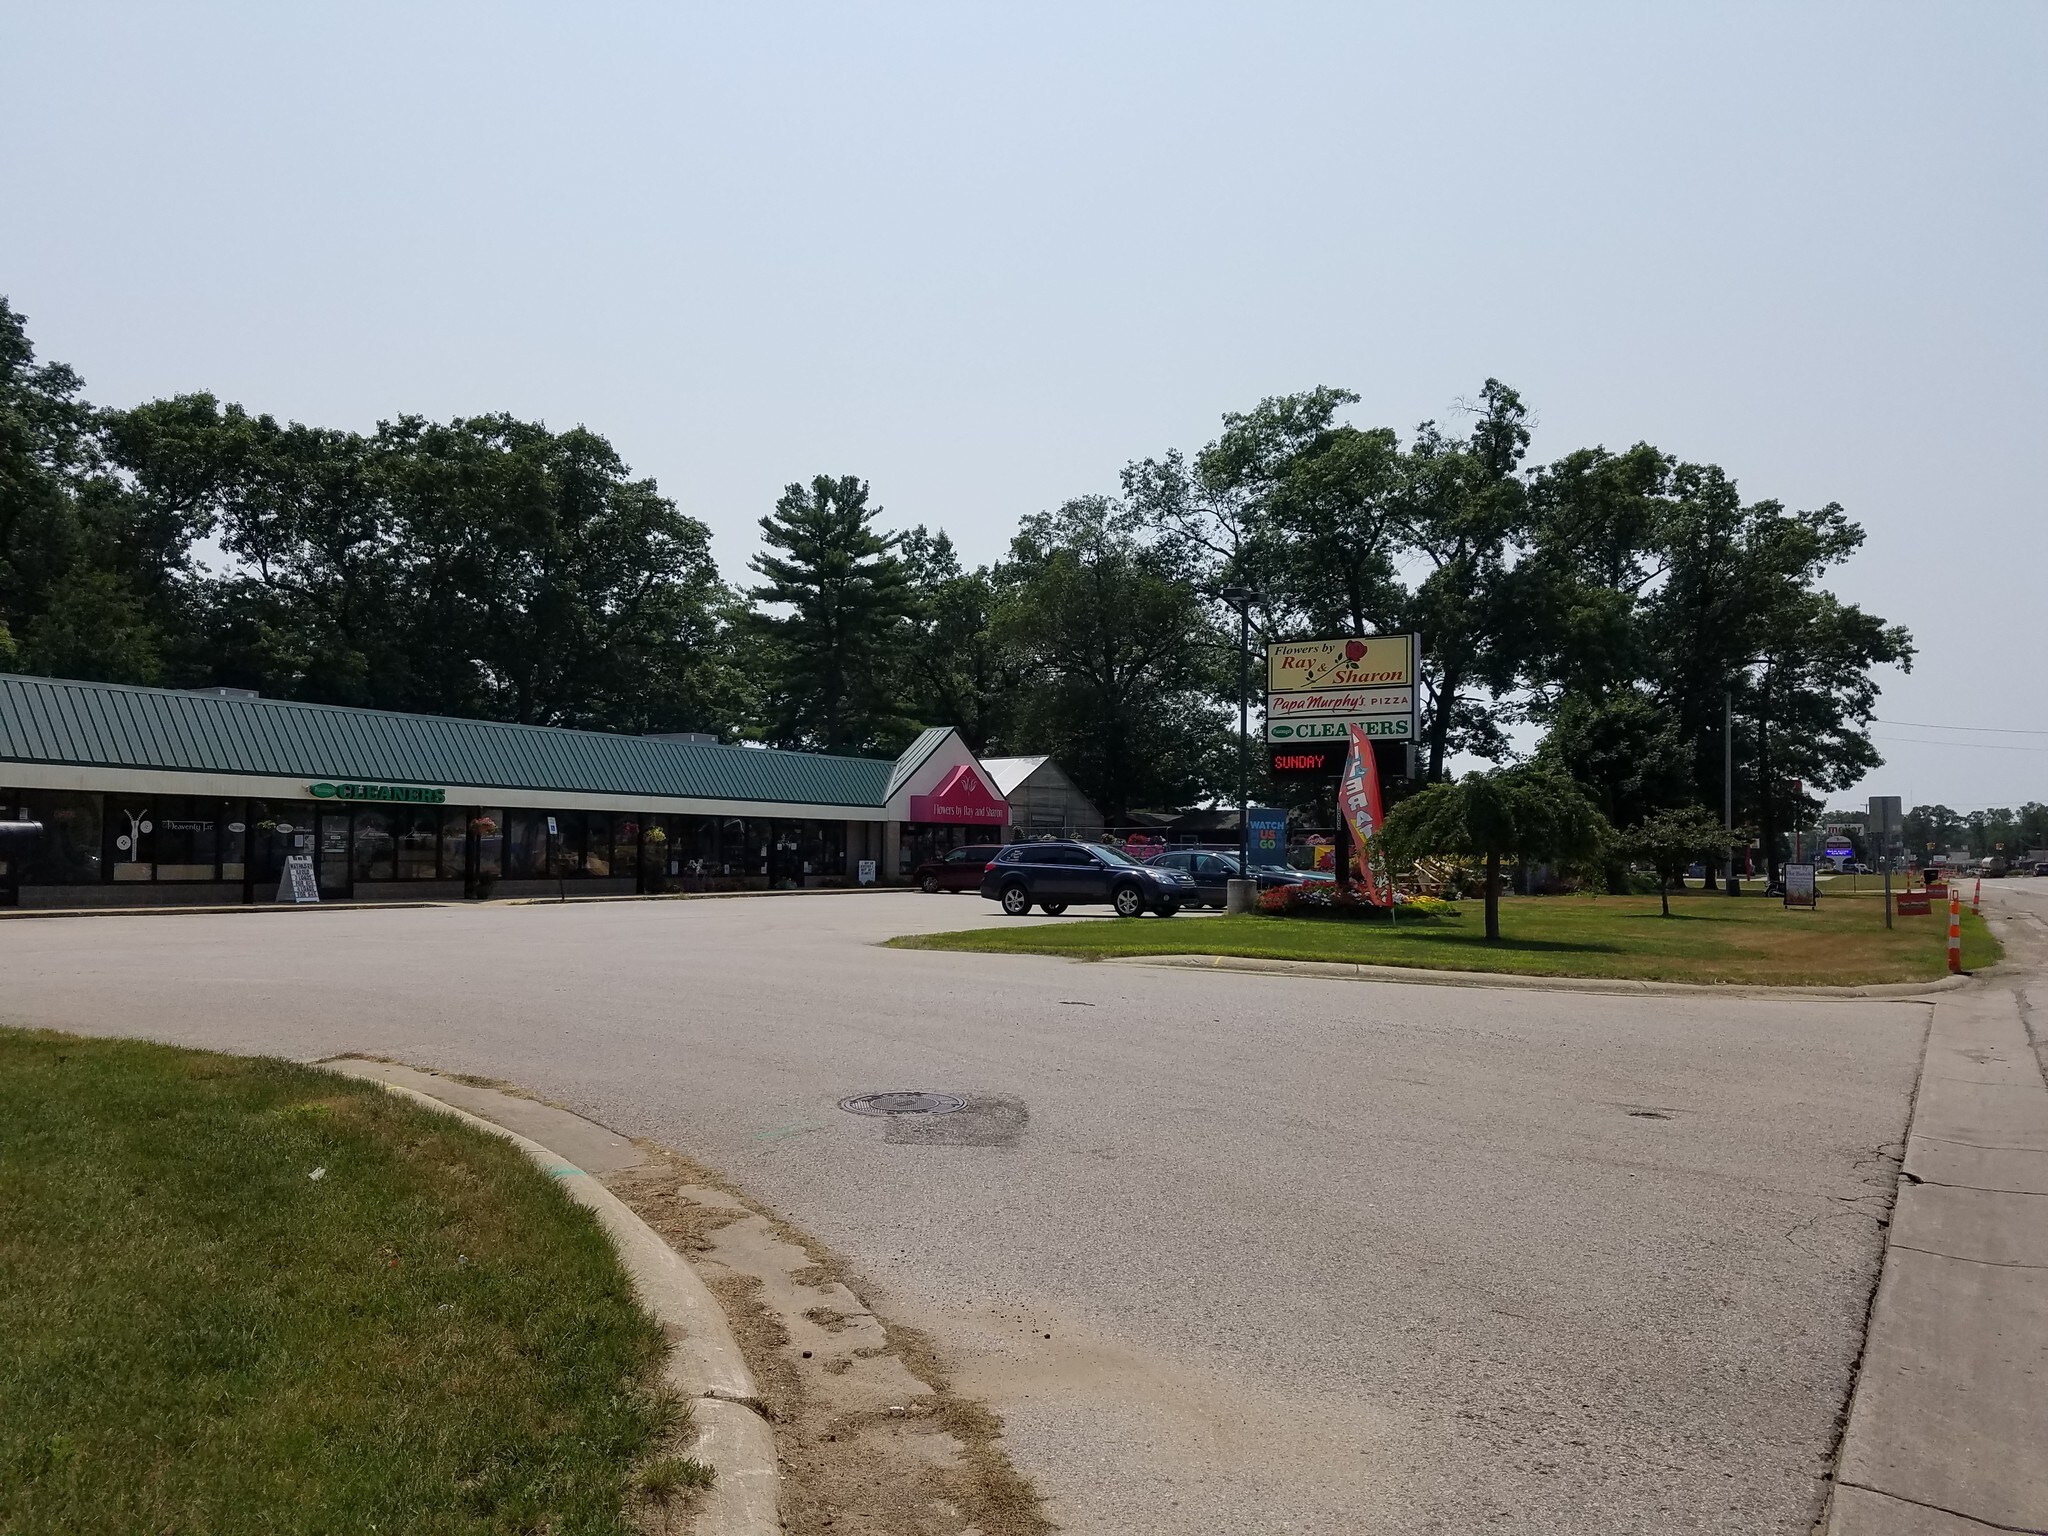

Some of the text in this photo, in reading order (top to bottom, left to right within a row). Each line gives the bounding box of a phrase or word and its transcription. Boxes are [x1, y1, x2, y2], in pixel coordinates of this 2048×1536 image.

[1274, 643, 1336, 656] Flowers by
[1280, 656, 1328, 673] Ray &
[1332, 669, 1403, 685] Sharon
[1371, 696, 1409, 706] PIZZA
[1274, 755, 1325, 770] SUNDAY
[337, 784, 446, 803] CLEANERS
[933, 803, 1004, 819] Flowers by Ray and Sharon
[1250, 821, 1284, 830] WATCH
[1259, 830, 1276, 839] US
[1259, 839, 1276, 849] GO
